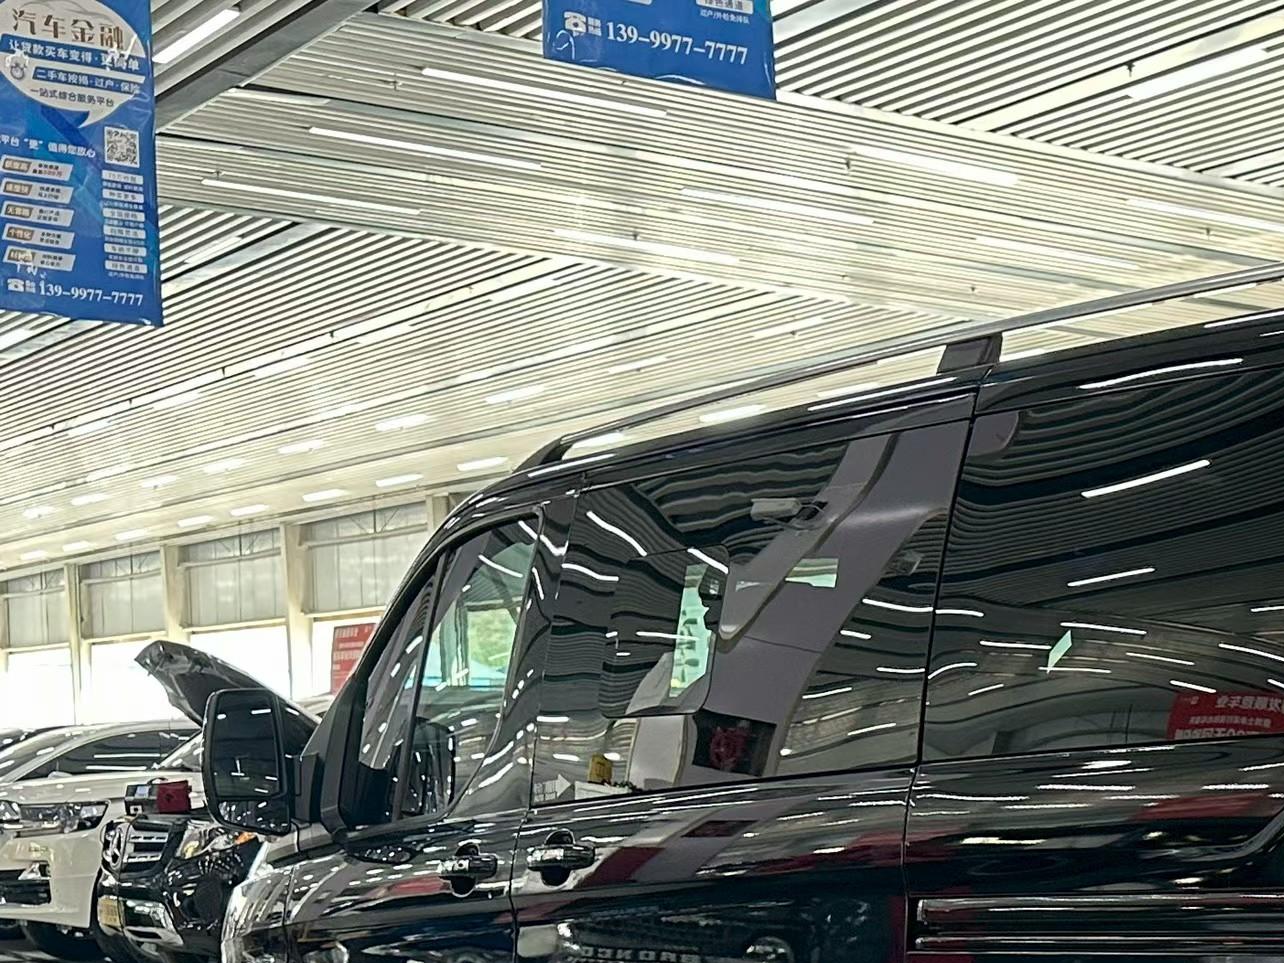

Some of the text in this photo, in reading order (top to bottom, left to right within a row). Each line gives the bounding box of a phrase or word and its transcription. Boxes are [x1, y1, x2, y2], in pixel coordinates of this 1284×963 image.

[12, 8, 124, 49] 汽车金融
[606, 22, 748, 65] 139-9977-7777
[38, 280, 144, 307] 139-9977-7777
